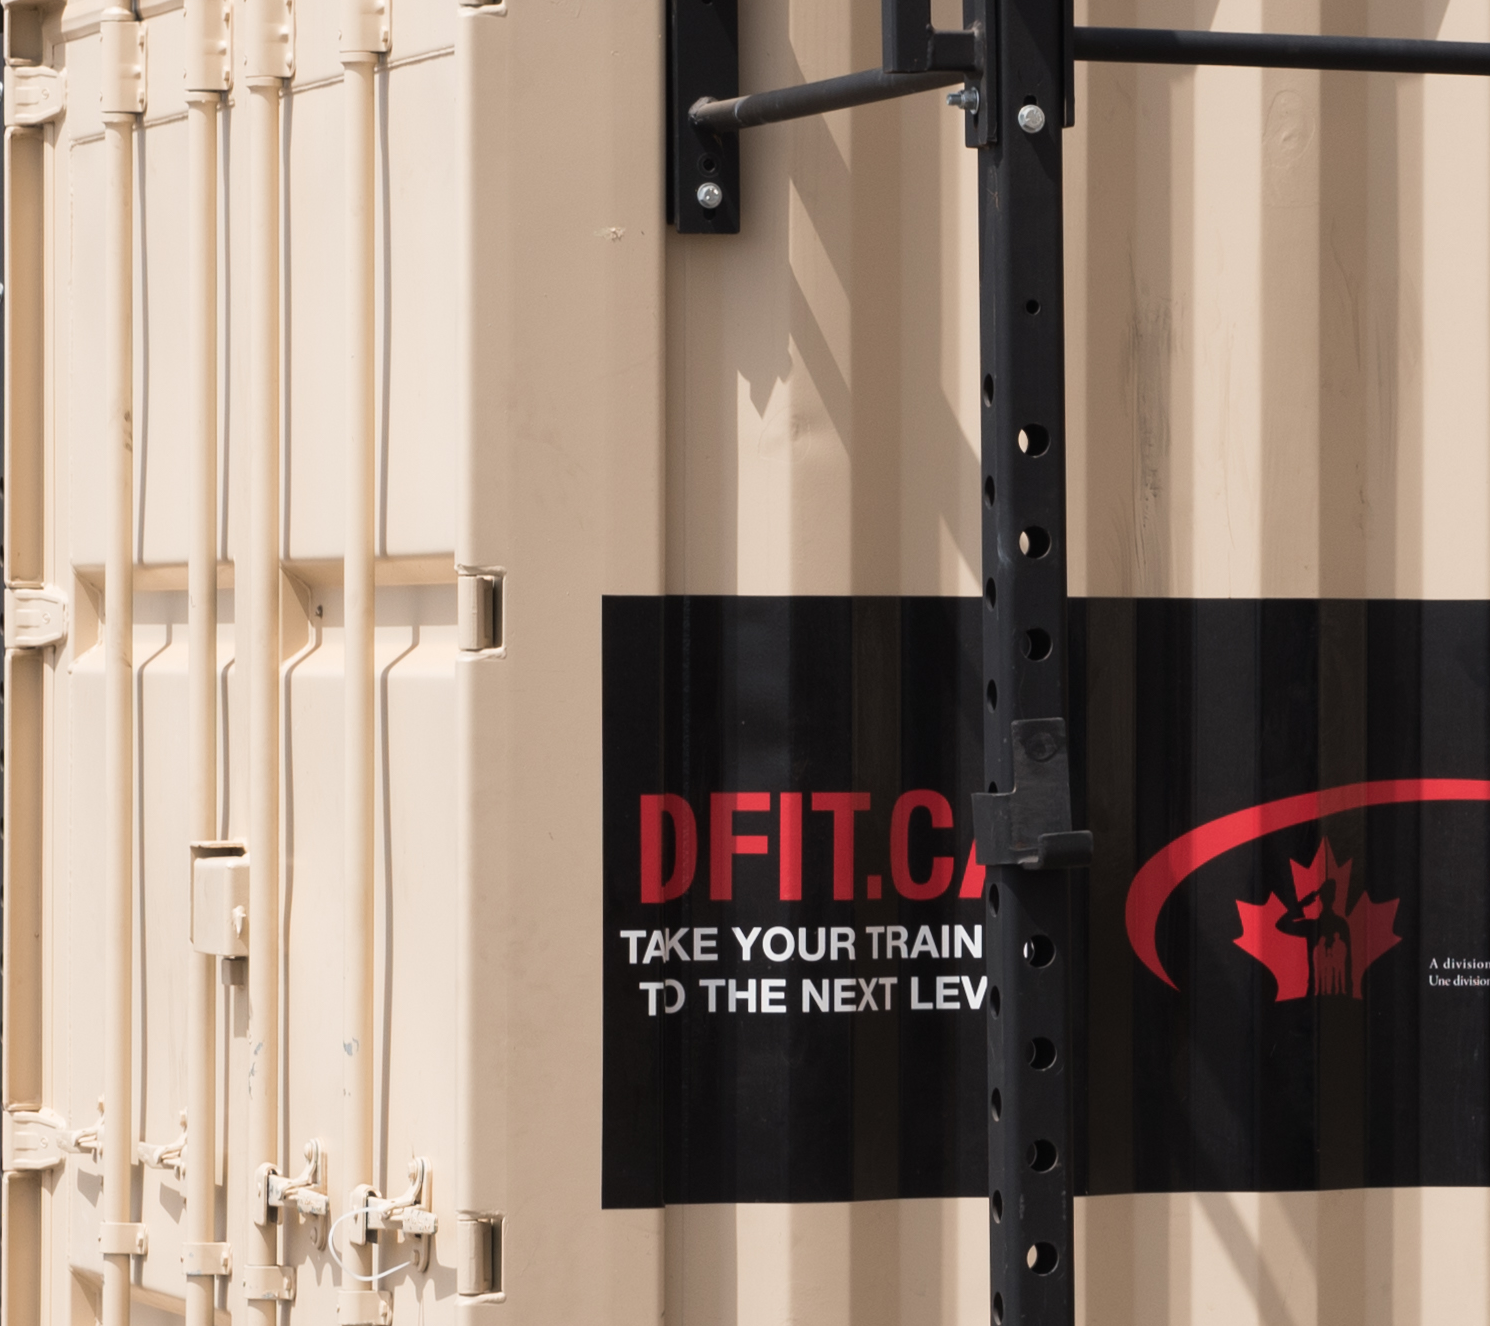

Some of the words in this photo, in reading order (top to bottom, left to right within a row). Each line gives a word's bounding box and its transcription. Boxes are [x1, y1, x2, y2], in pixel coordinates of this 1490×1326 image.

[620, 926, 718, 964] TAKE
[732, 925, 856, 962] YOUR
[865, 924, 983, 960] TRAIN
[1429, 958, 1439, 969] A
[1429, 975, 1451, 986] Une
[639, 978, 685, 1017] TO
[699, 977, 787, 1014] THE
[802, 976, 898, 1013] NEXT
[910, 975, 988, 1011] LEV
